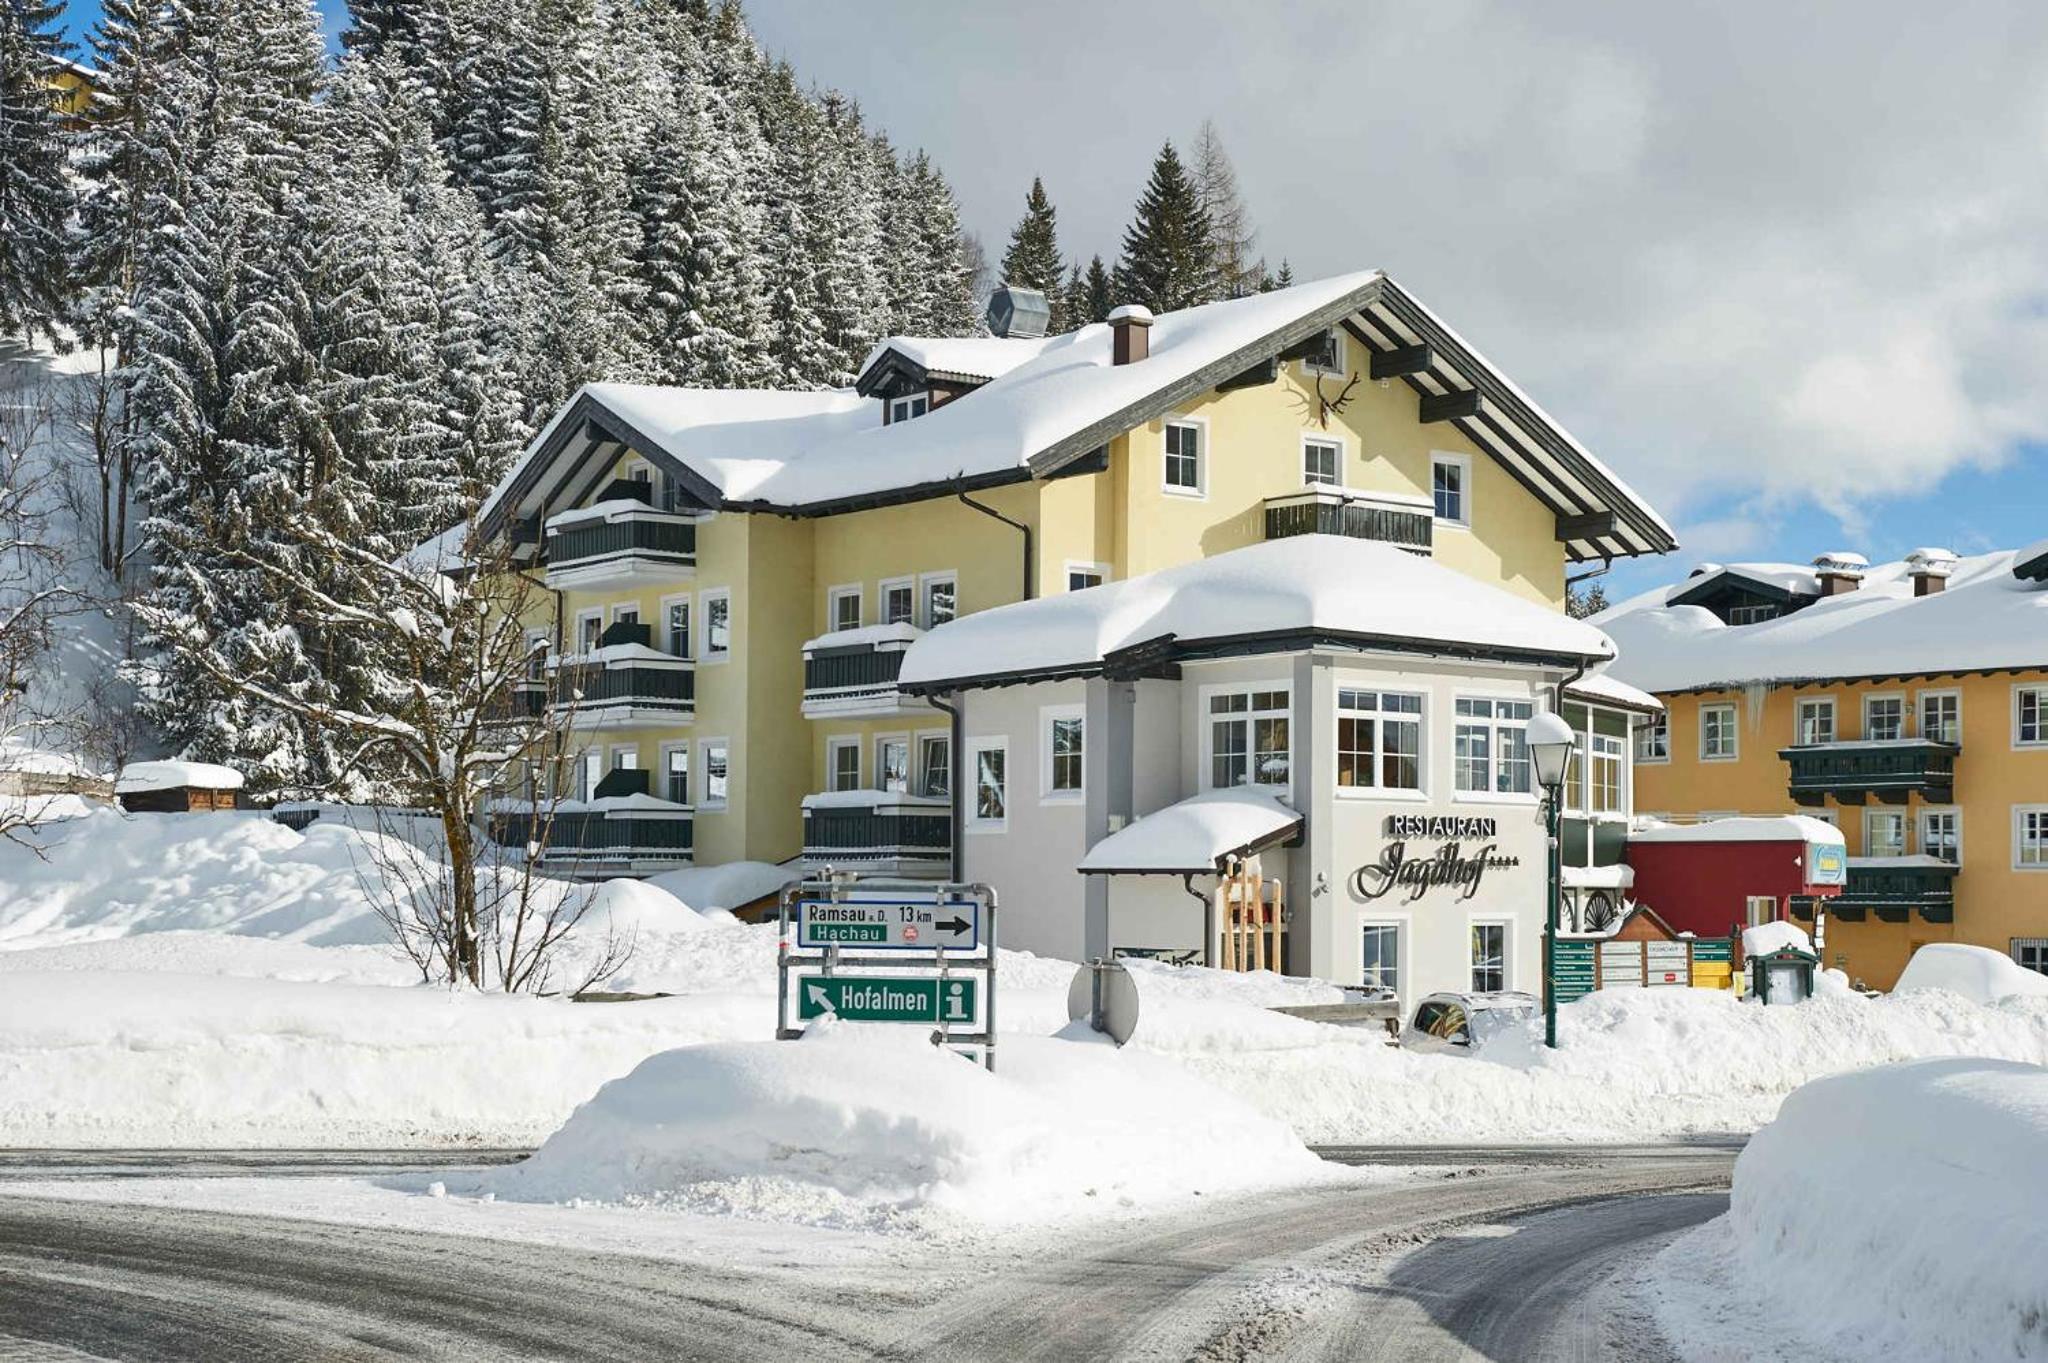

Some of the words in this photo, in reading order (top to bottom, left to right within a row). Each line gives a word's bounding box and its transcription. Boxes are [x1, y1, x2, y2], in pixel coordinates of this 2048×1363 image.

[1357, 841, 1497, 900] Jagdhof
[809, 905, 866, 922] Ramsau
[899, 906, 914, 923] 13
[916, 909, 932, 923] km
[817, 925, 880, 940] Hachau
[841, 985, 928, 1011] Hofalmen
